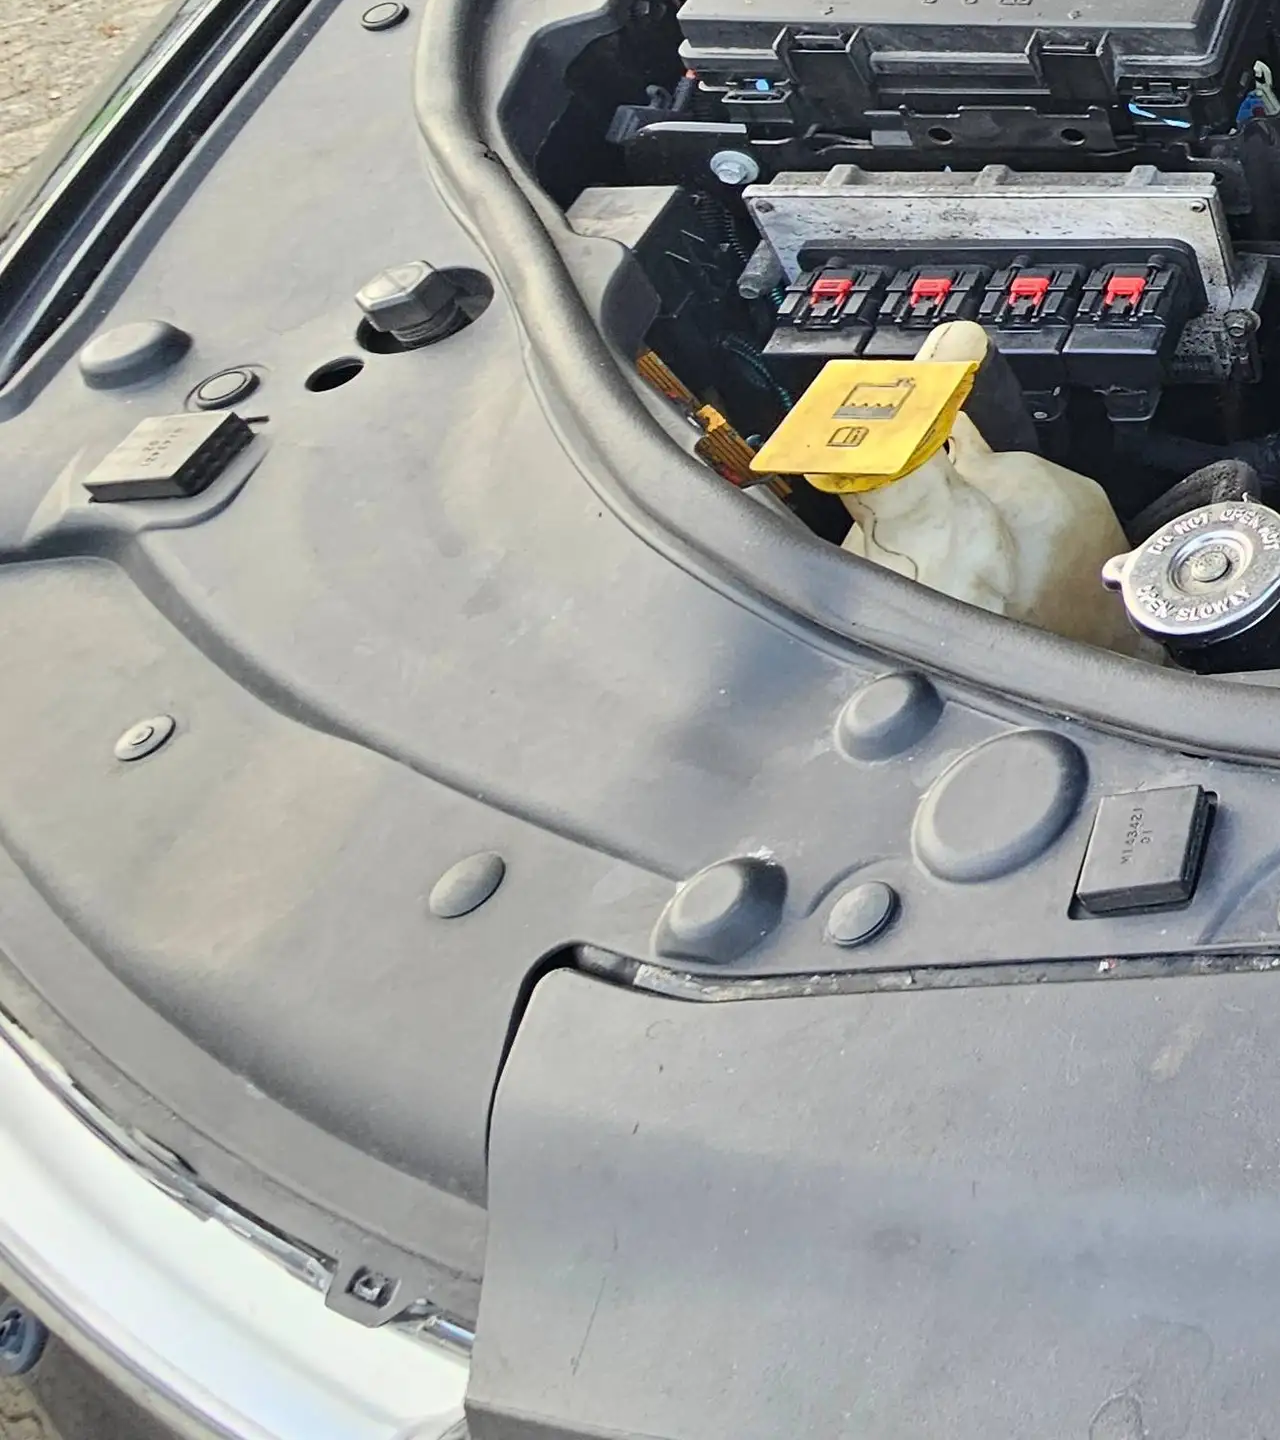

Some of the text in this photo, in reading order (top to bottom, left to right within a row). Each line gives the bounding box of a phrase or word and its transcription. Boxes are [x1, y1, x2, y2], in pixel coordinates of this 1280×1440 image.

[1146, 534, 1175, 556] DO
[1174, 512, 1211, 536] NOT
[1219, 508, 1264, 532] OPEN
[1135, 584, 1253, 622] OPEN SLOWLY
